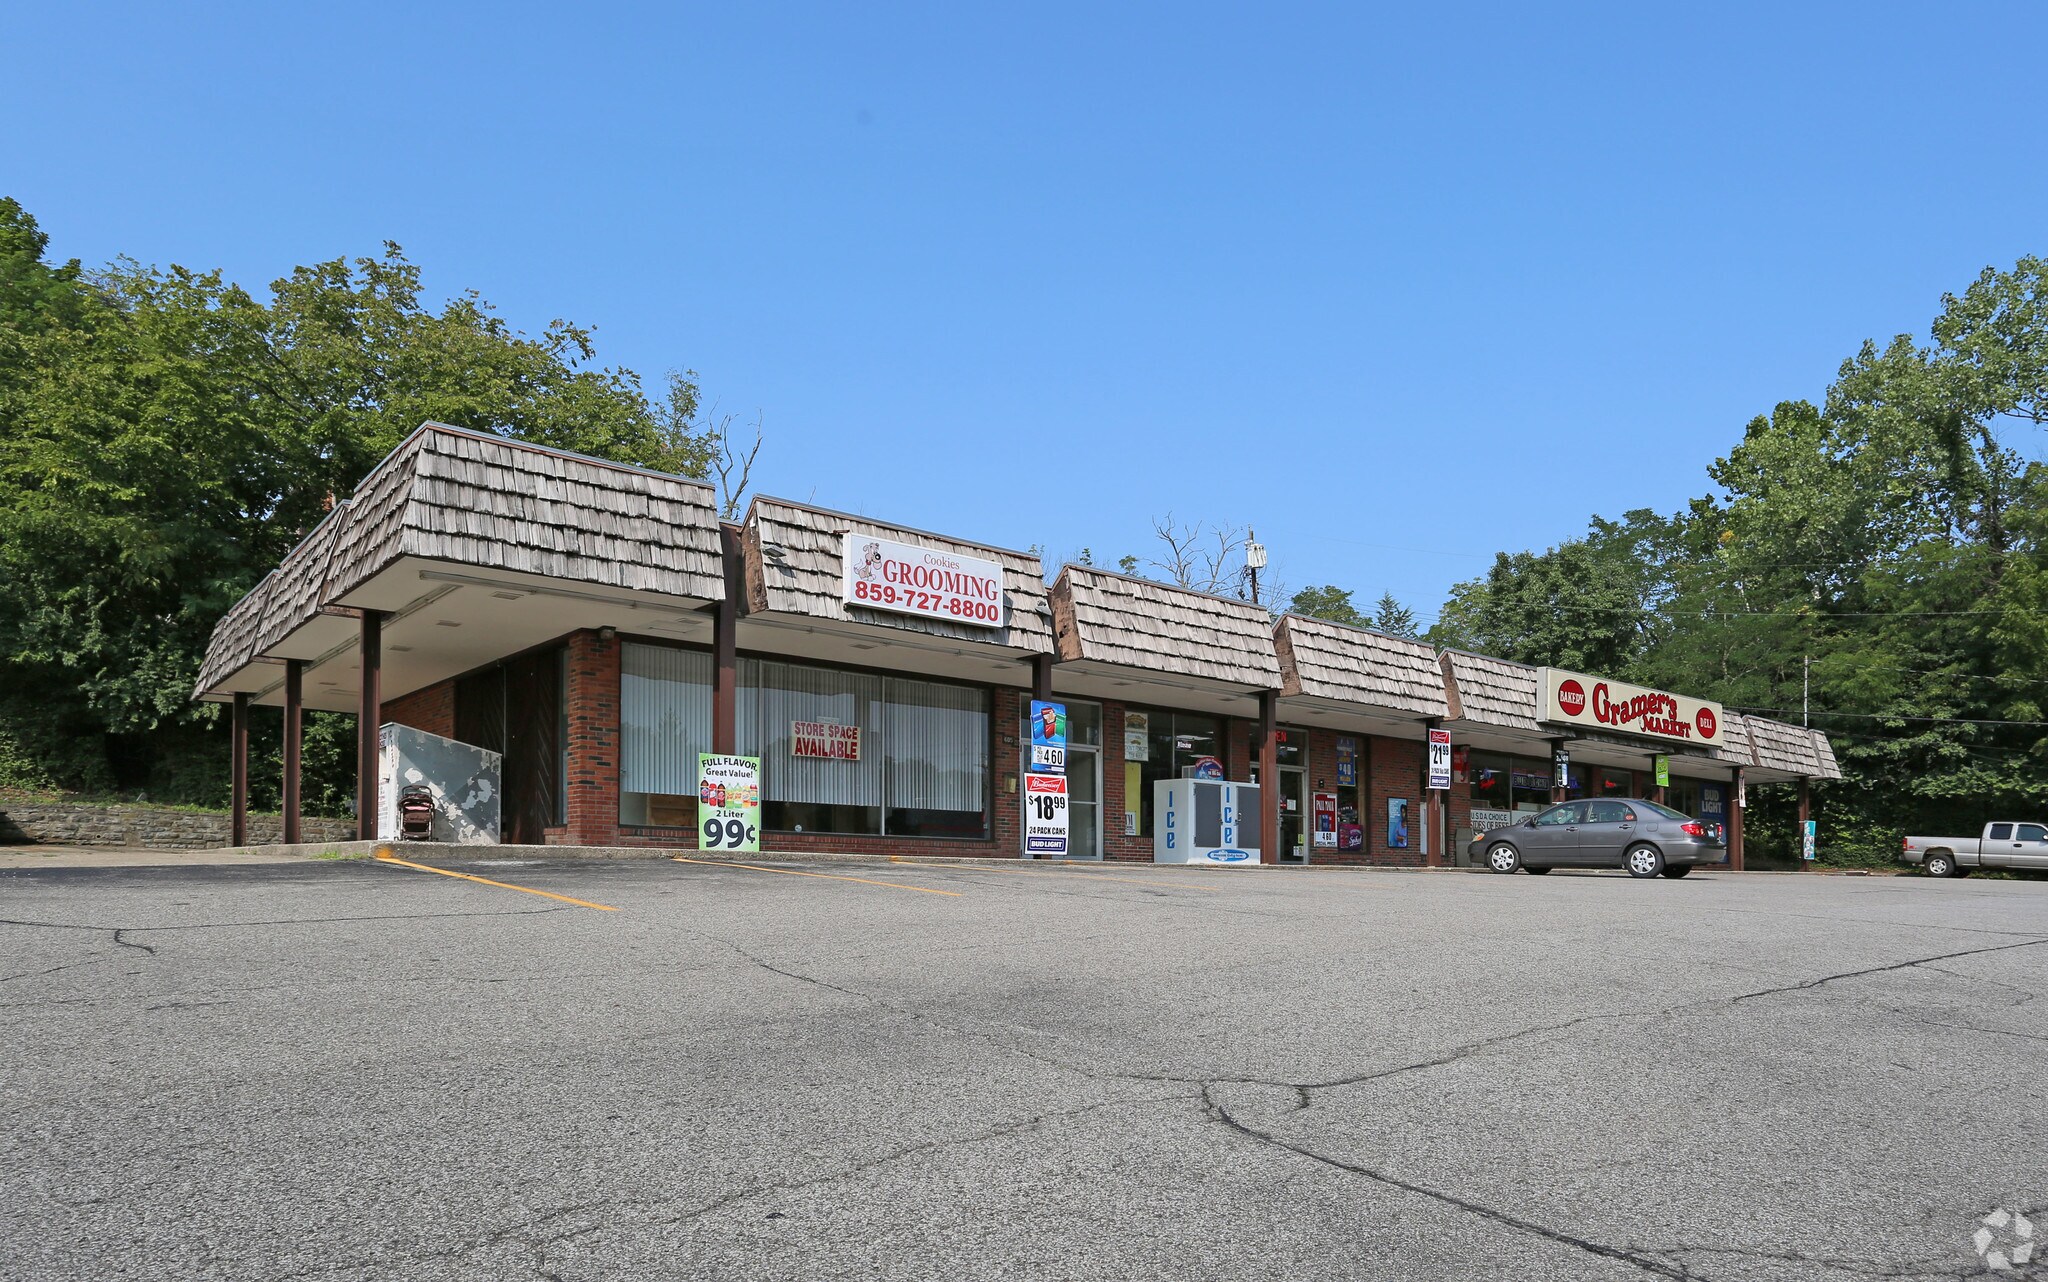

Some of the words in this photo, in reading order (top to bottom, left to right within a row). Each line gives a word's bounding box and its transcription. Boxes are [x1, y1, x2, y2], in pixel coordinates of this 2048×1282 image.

[924, 553, 960, 570] Cookies
[883, 559, 998, 601] GROOMING
[855, 581, 999, 622] 859-727-8800
[1559, 690, 1585, 706] BAKERY
[1592, 682, 1678, 726] Gramer's
[1640, 715, 1692, 738] MARKET
[1699, 716, 1713, 729] DELI
[794, 721, 825, 737] STORE
[828, 724, 858, 740] SPACE
[1276, 731, 1287, 742] EN
[794, 736, 858, 760] AVAILABLE
[701, 757, 723, 768] FULL
[705, 767, 727, 777] Great
[728, 769, 753, 778] Value!
[1032, 780, 1060, 788] Budweiser
[1704, 789, 1719, 802] BUD
[1315, 800, 1325, 811] PALL
[1325, 800, 1335, 812] MALL
[1701, 801, 1722, 814] LIGHT
[715, 809, 722, 818] 2
[723, 810, 745, 818] Liter
[1488, 813, 1507, 821] CHOICE
[703, 818, 756, 849] 99¢
[1029, 826, 1037, 834] 24
[1037, 826, 1051, 835] PACK
[1051, 827, 1066, 836] CANS
[1030, 840, 1044, 848] BUD
